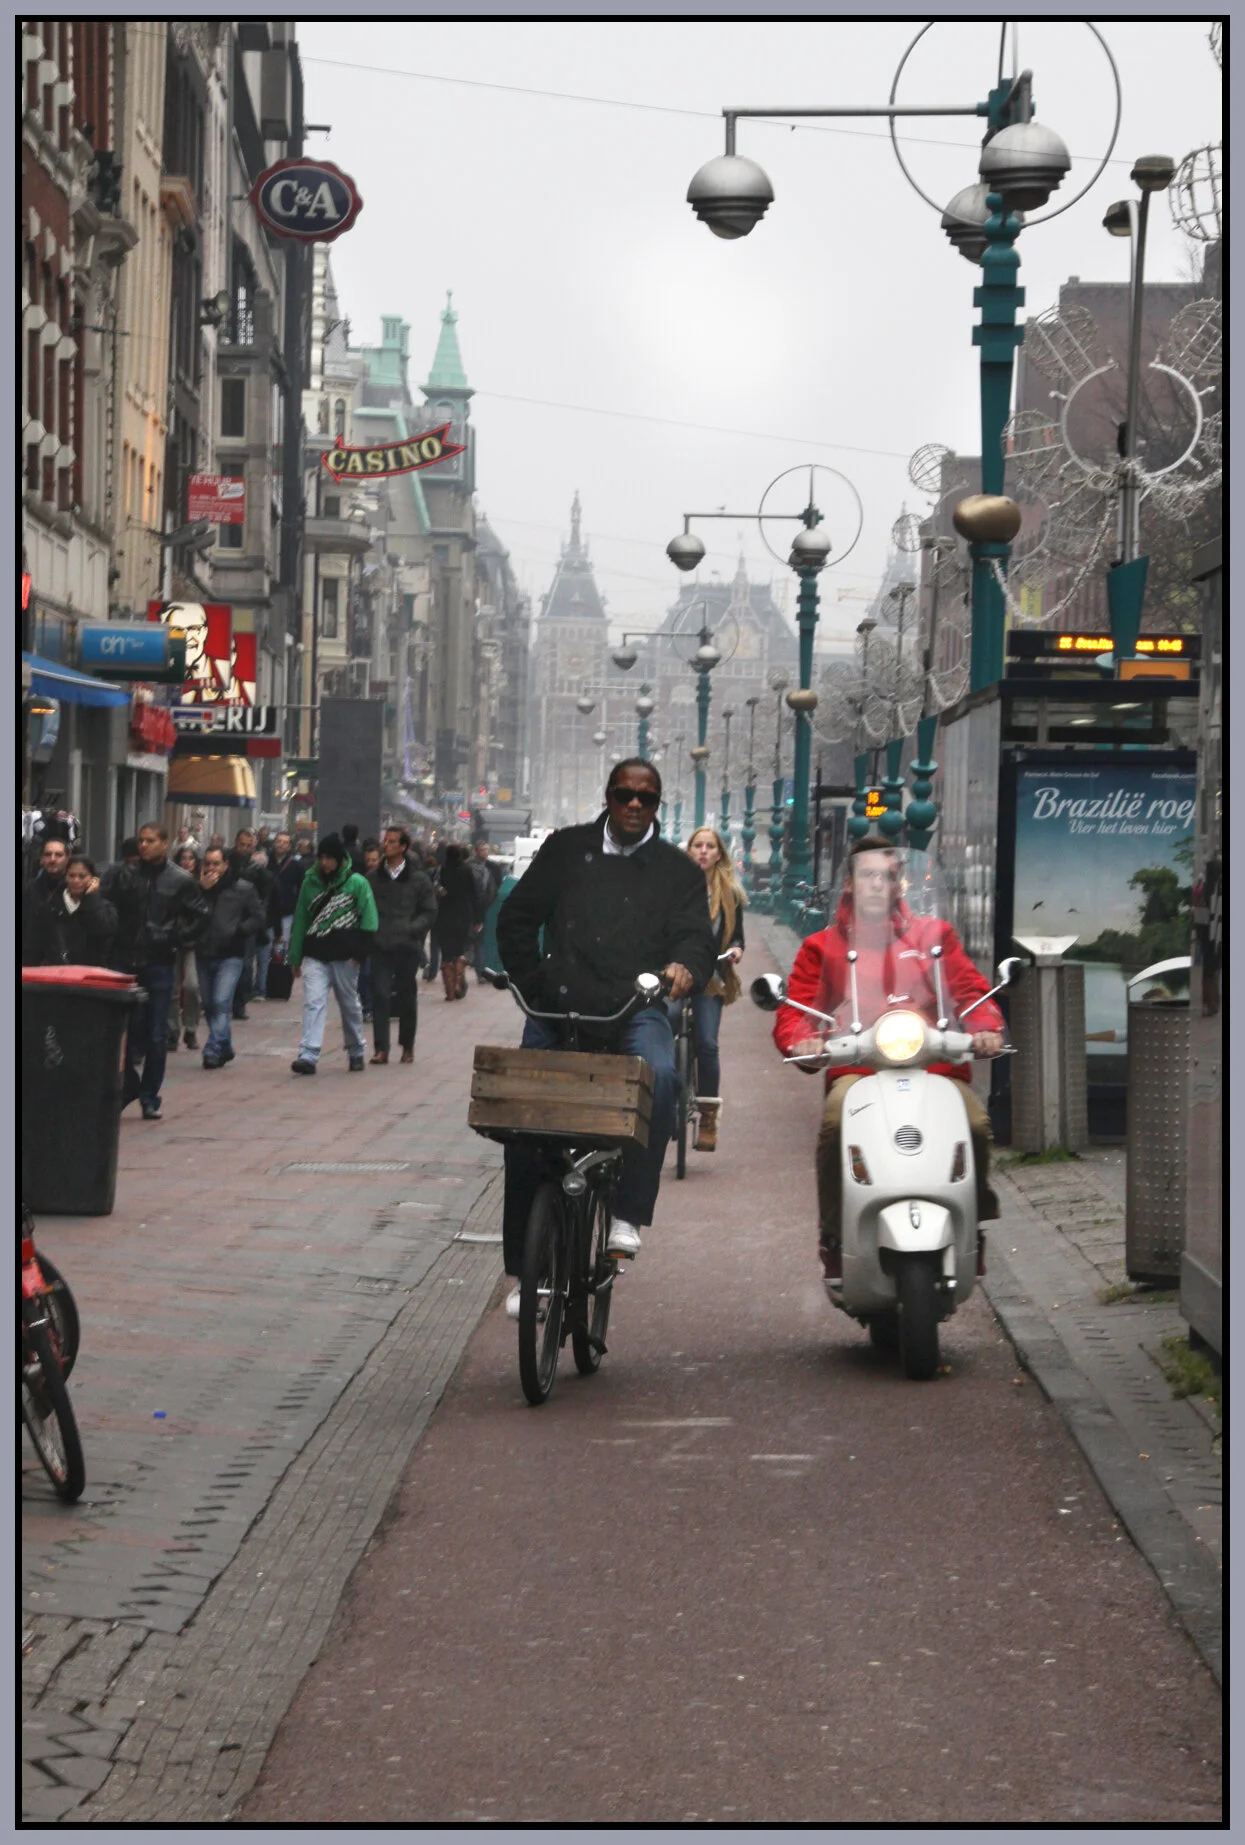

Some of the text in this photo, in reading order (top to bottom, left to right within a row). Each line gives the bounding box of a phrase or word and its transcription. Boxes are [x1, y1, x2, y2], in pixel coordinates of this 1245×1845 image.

[269, 179, 341, 219] C&A
[327, 437, 442, 473] CASINO
[1032, 787, 1146, 820] Brazilië
[1068, 818, 1177, 835] Vier het leven hier
